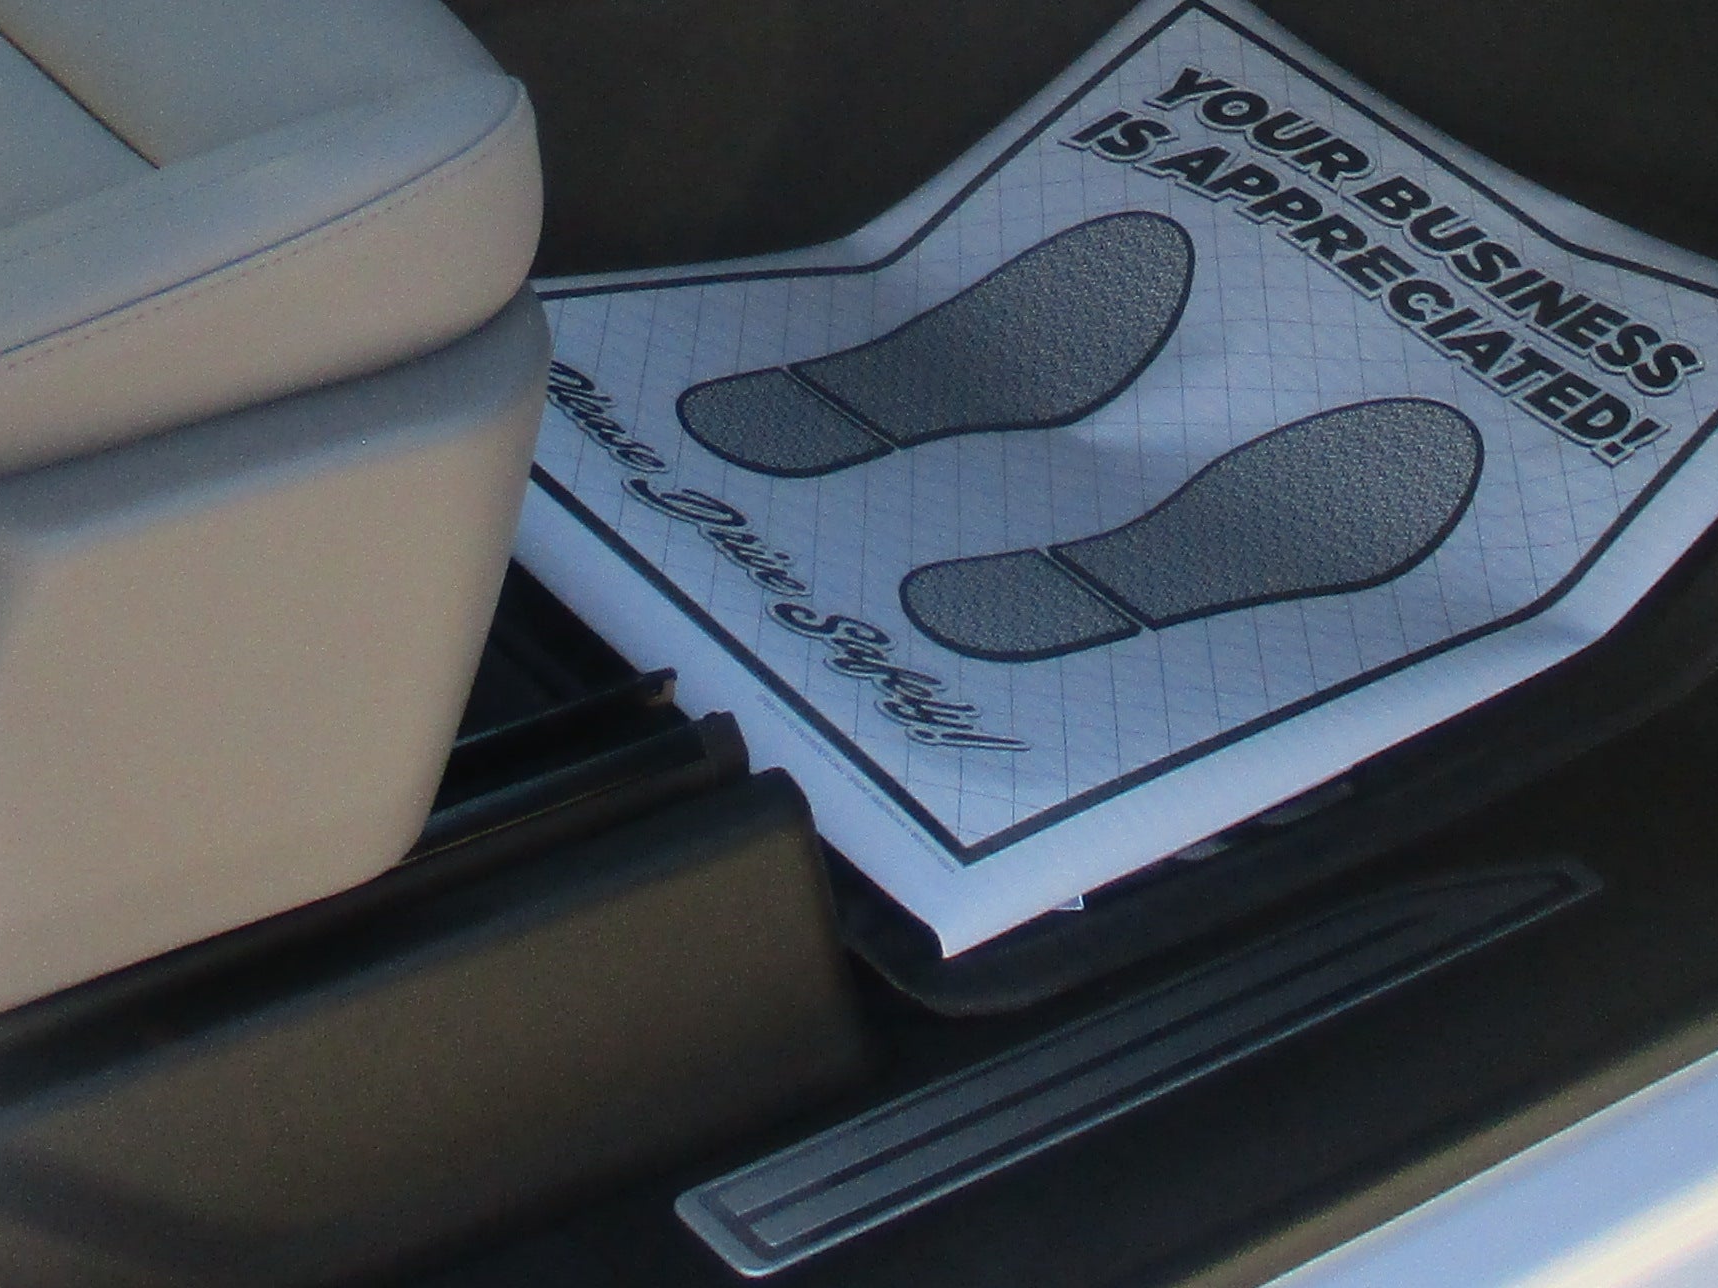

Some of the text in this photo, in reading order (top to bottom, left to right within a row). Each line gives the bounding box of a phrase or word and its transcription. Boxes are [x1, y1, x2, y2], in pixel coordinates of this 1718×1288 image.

[1061, 111, 1669, 466] IS APPRECIATED!
[1146, 66, 1703, 396] YOUR BUSINESS
[621, 478, 811, 596] Drive
[767, 601, 1030, 750] Safely!
